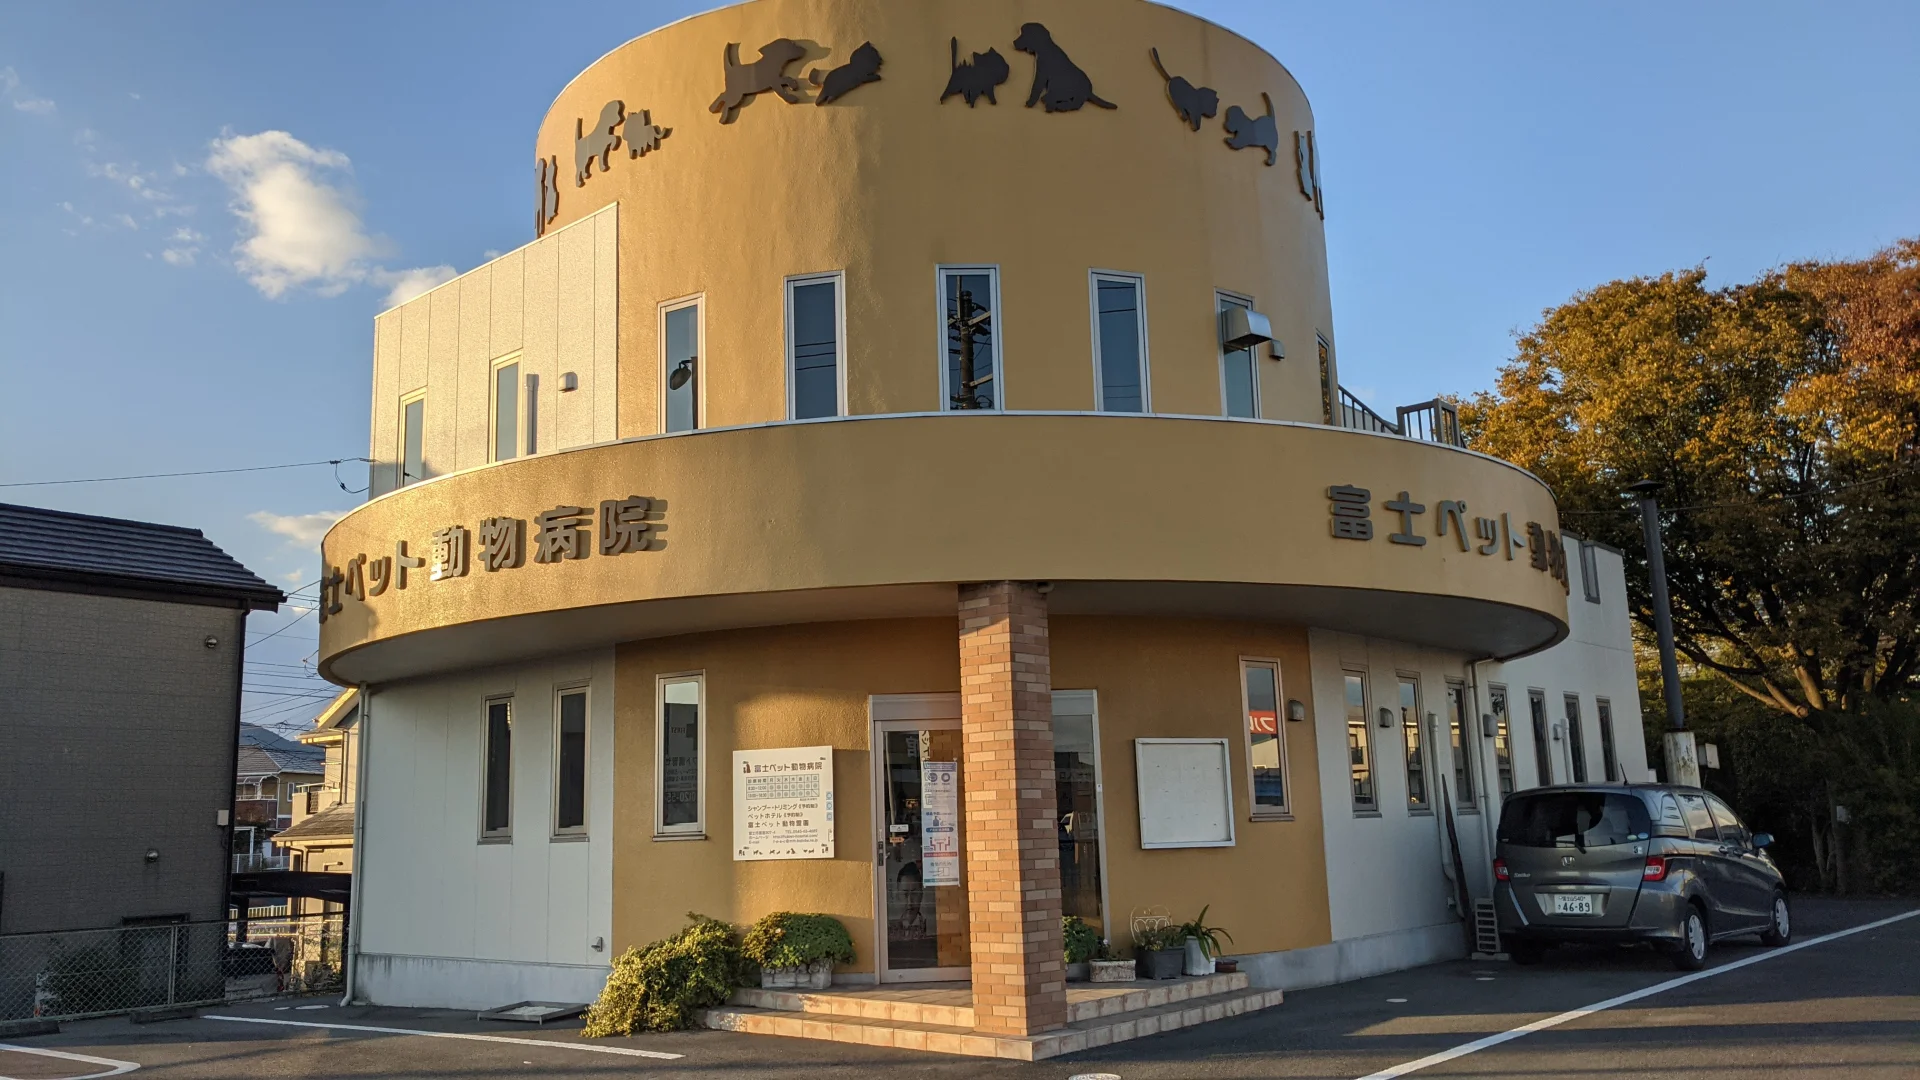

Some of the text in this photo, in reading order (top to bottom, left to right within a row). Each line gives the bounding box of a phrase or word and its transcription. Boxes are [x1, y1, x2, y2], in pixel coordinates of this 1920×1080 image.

[754, 762, 822, 772] 富士ペット動物病院
[1563, 902, 1590, 912] 46-89
